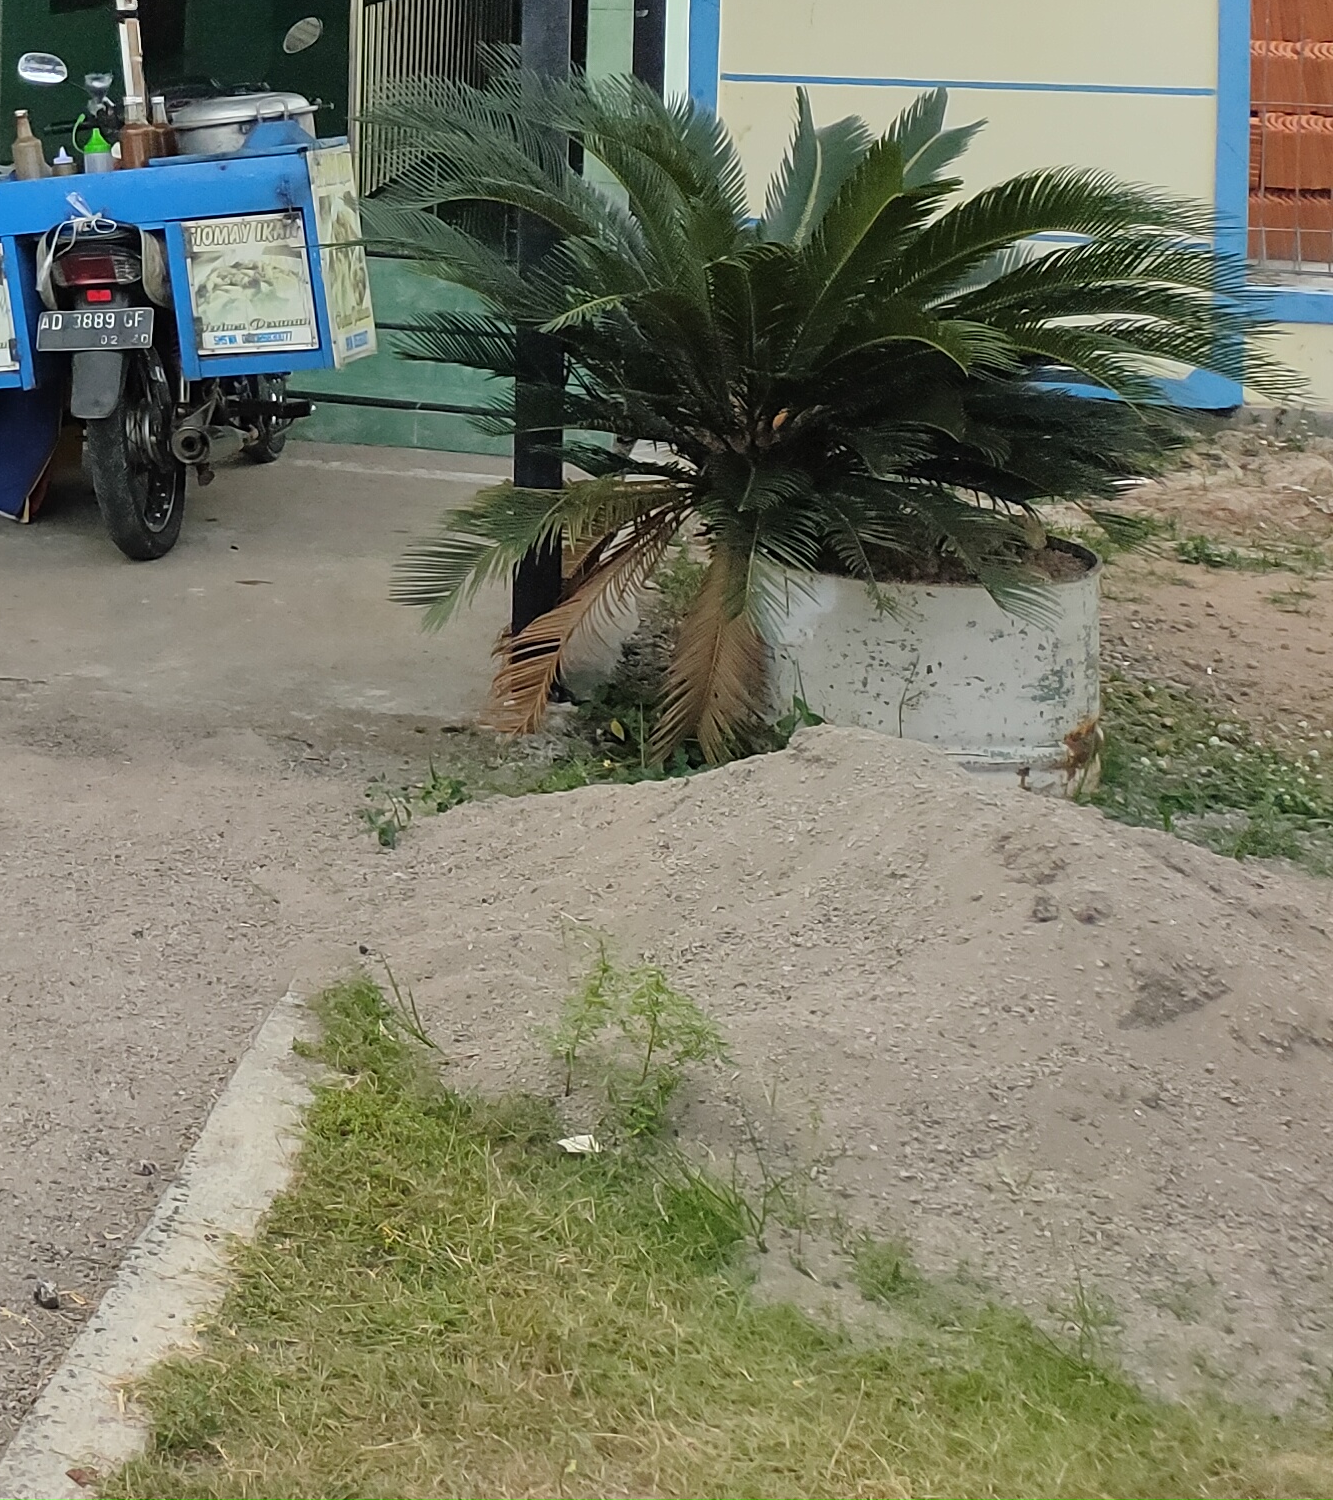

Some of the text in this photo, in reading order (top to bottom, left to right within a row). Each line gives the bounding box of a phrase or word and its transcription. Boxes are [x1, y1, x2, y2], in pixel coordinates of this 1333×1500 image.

[40, 313, 63, 331] AD
[123, 310, 145, 328] GF
[100, 334, 118, 345] 02
